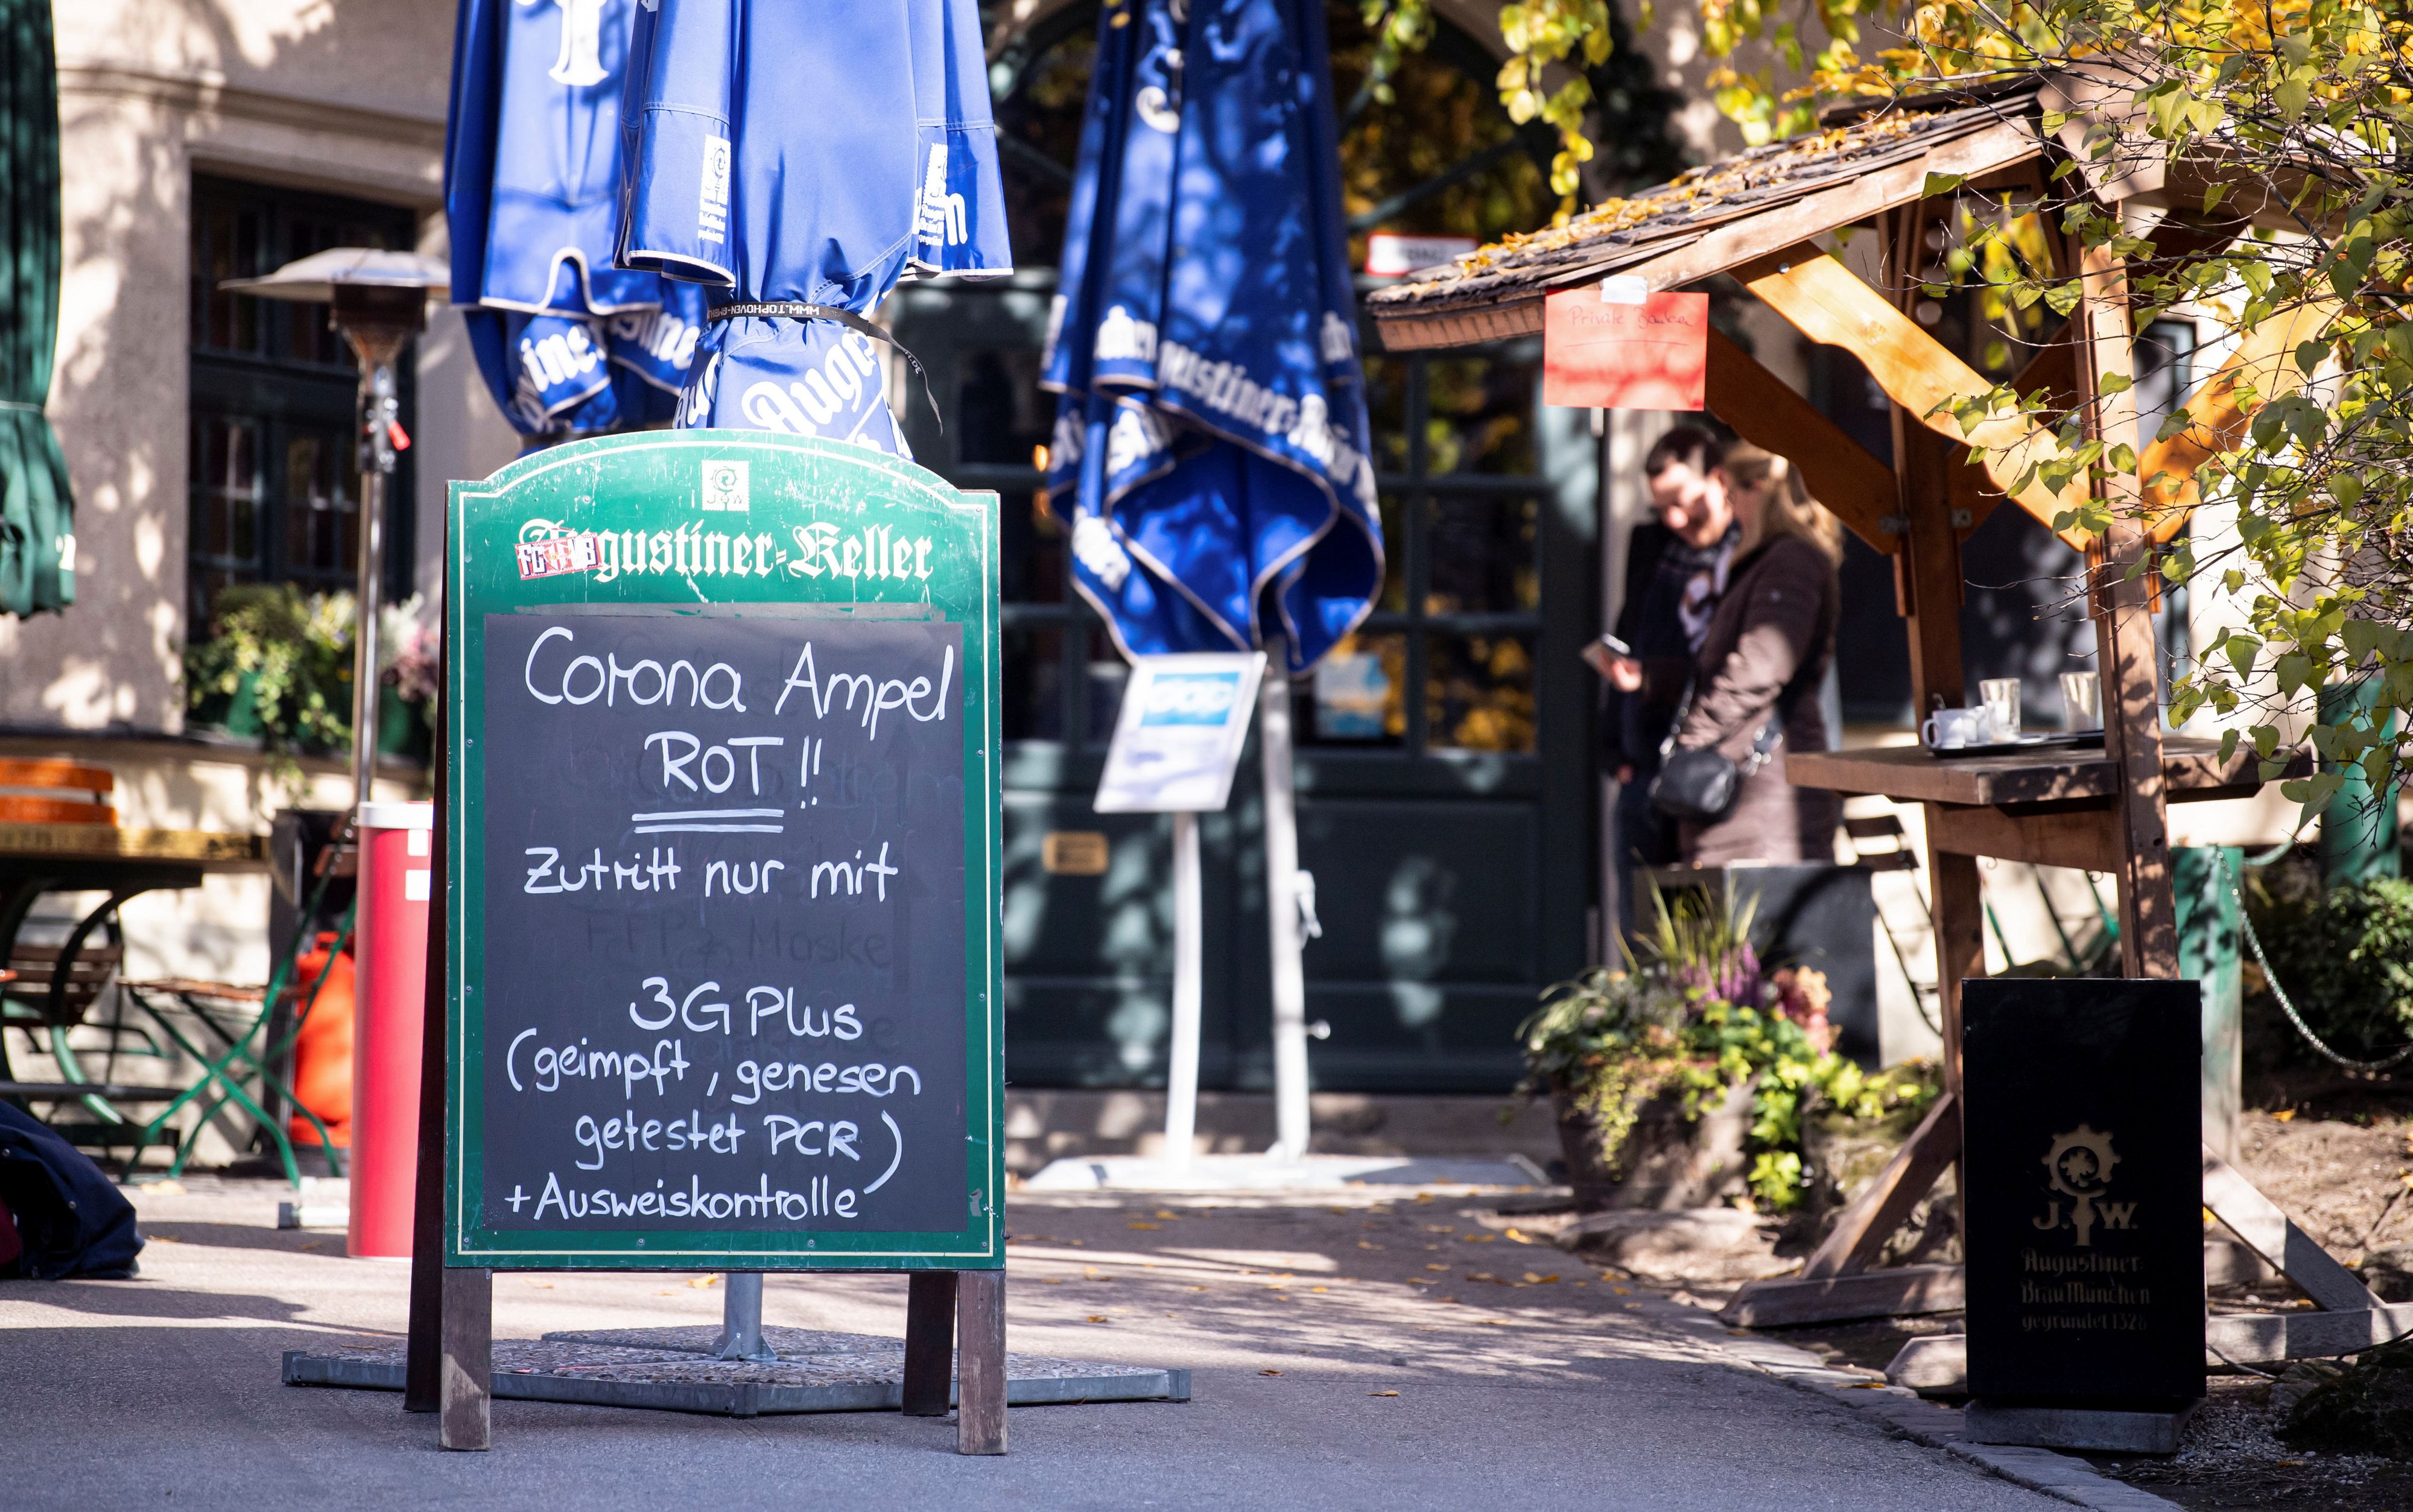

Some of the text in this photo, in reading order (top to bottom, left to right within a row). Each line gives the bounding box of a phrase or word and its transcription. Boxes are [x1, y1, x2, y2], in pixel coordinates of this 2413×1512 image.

[525, 626, 954, 741] Corona Ampel
[524, 841, 898, 902] Zutritt nur mit
[629, 976, 730, 1036] 3G
[746, 986, 863, 1040] Plus
[731, 1060, 921, 1105] genesen
[575, 1109, 746, 1170] getestet
